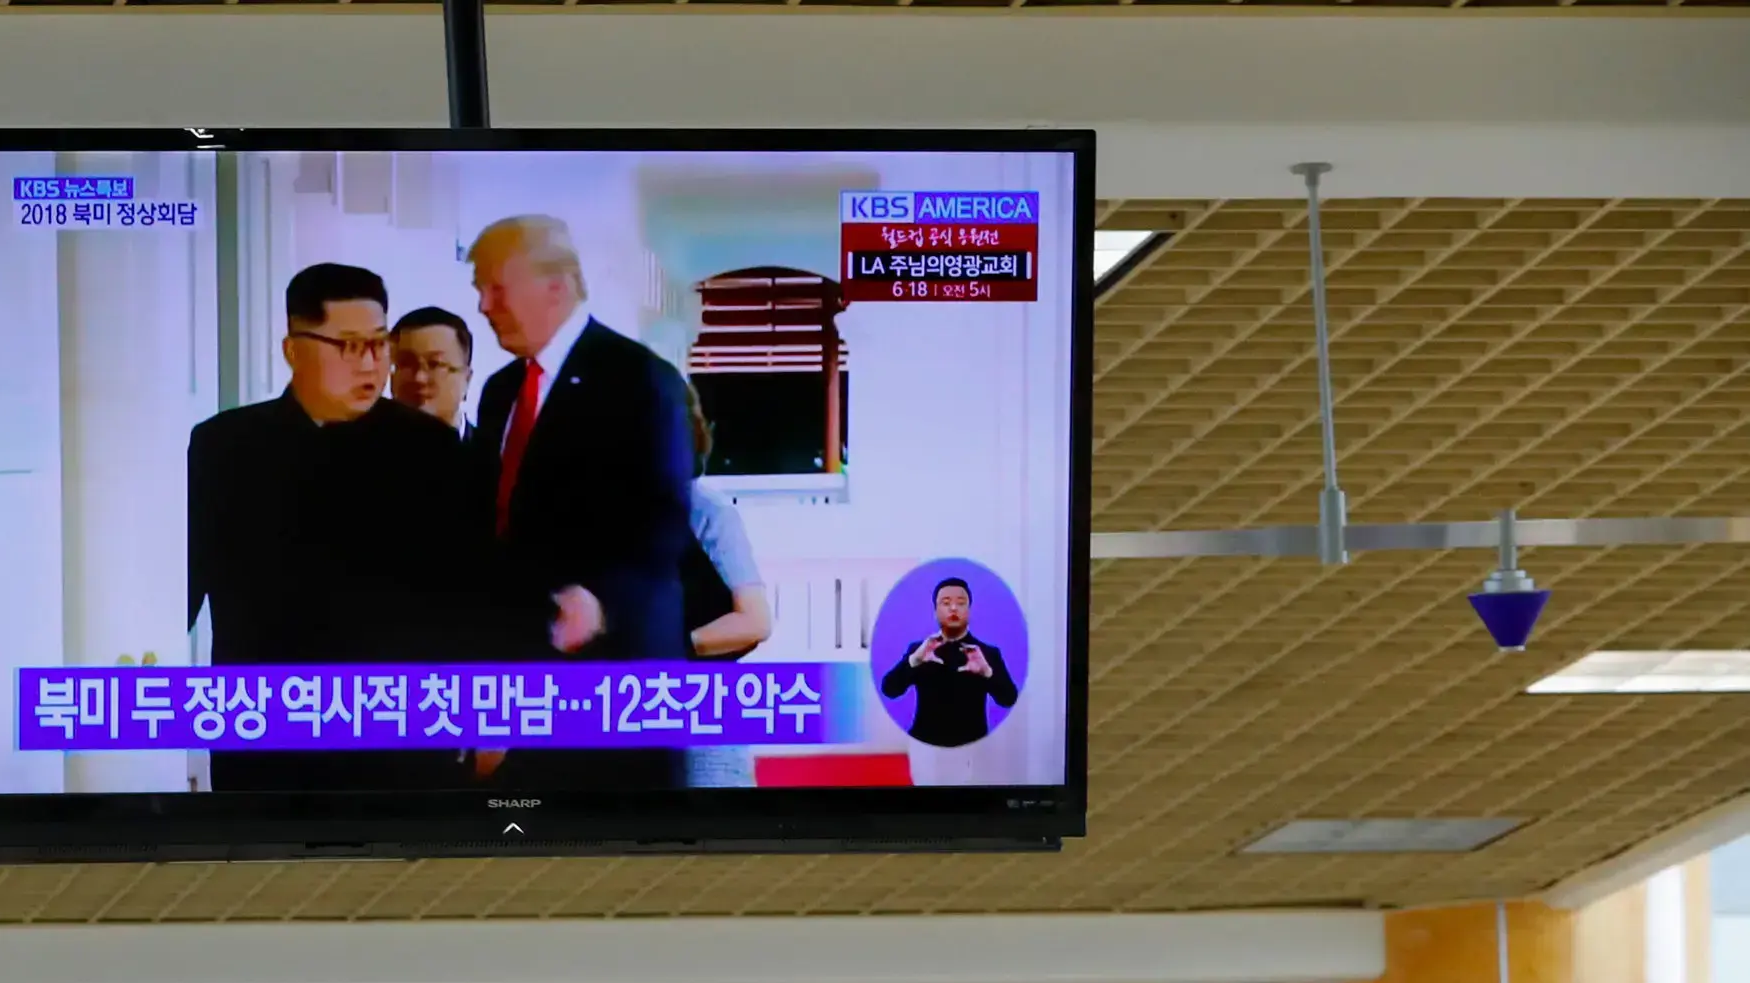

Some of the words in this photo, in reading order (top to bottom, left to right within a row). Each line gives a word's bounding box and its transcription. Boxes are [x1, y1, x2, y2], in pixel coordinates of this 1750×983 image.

[19, 180, 59, 198] KBS
[64, 179, 129, 198] 뉴스특보
[21, 204, 67, 225] 2018
[72, 203, 111, 225] 북미
[116, 203, 197, 225] 정상회담
[851, 196, 909, 218] KBS
[918, 196, 1031, 218] AMERICA
[881, 226, 924, 249] 월드컵
[928, 227, 953, 247] 공식
[861, 257, 885, 275] LA
[889, 254, 1017, 277] 주님의영광교회
[942, 284, 965, 298] 오전
[969, 281, 991, 298] 5시
[34, 675, 120, 739] 북미
[131, 676, 175, 738] 두
[183, 675, 272, 740] 정상
[280, 674, 409, 738] 역사적
[418, 672, 463, 738] 첫
[737, 671, 821, 734] 악수
[487, 798, 542, 809] SHARP
